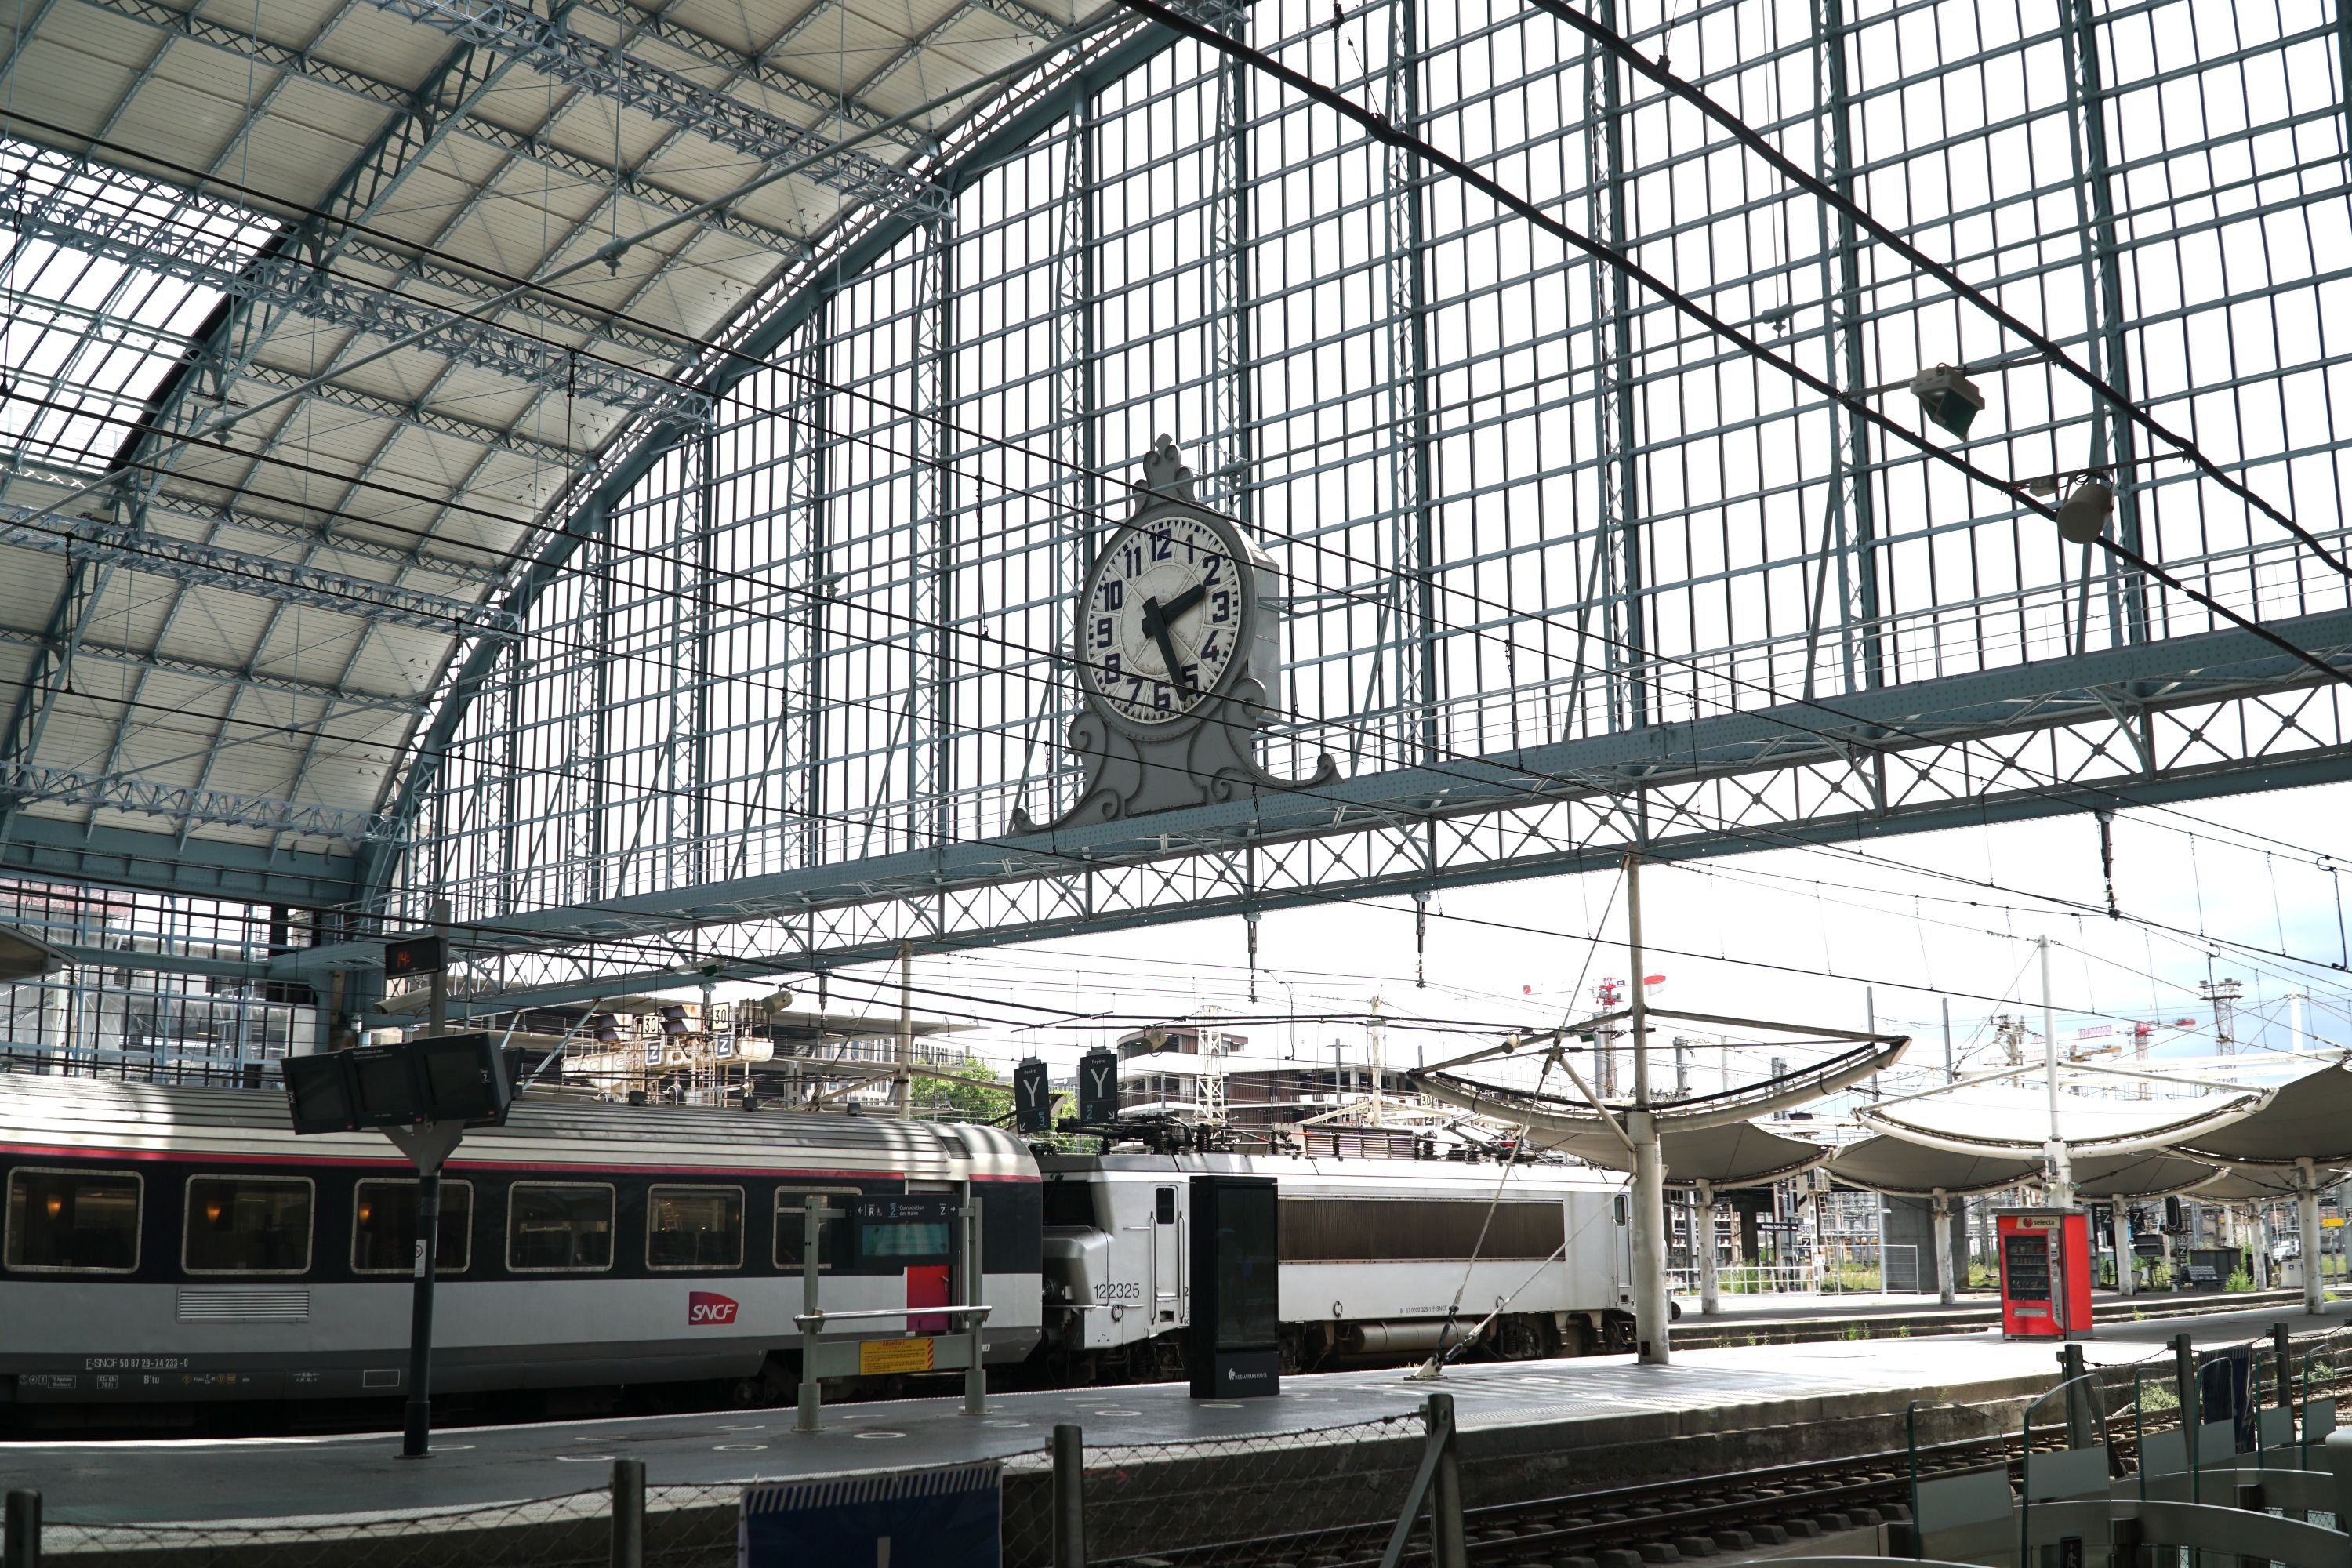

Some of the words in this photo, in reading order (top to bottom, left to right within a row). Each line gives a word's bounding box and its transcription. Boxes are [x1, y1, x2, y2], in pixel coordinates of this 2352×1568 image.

[1150, 528, 1172, 562] 12
[1185, 534, 1194, 564] 1
[1124, 546, 1142, 579] 11
[1203, 555, 1220, 586] 2
[1104, 579, 1123, 612] 10
[1211, 590, 1229, 623] 3
[1097, 617, 1113, 649] 9
[1201, 630, 1219, 662] 4
[1104, 653, 1120, 684] 8
[1181, 663, 1198, 691] 5
[1127, 677, 1143, 708] 7
[1153, 681, 1171, 711] 6
[714, 1008, 727, 1025] 30
[644, 1018, 656, 1033] 30
[719, 1038, 728, 1053] Z
[1090, 1067, 1109, 1098] Y
[1023, 1076, 1040, 1107] Y
[1039, 1116, 1045, 1126] 3
[1087, 1109, 1093, 1120] 2
[869, 1207, 874, 1216] R
[891, 1207, 895, 1216] 2
[940, 1207, 946, 1215] Z
[2133, 1212, 2141, 1222] Z
[1802, 1225, 1810, 1234] 30
[1802, 1239, 1810, 1247] Z
[2177, 1236, 2187, 1244] 30
[1094, 1283, 1139, 1299] 122325
[691, 1304, 735, 1321] SNCF
[85, 1358, 118, 1369] F-SNCF
[120, 1358, 129, 1367] 50
[131, 1358, 140, 1367] 87
[165, 1358, 178, 1368] 233
